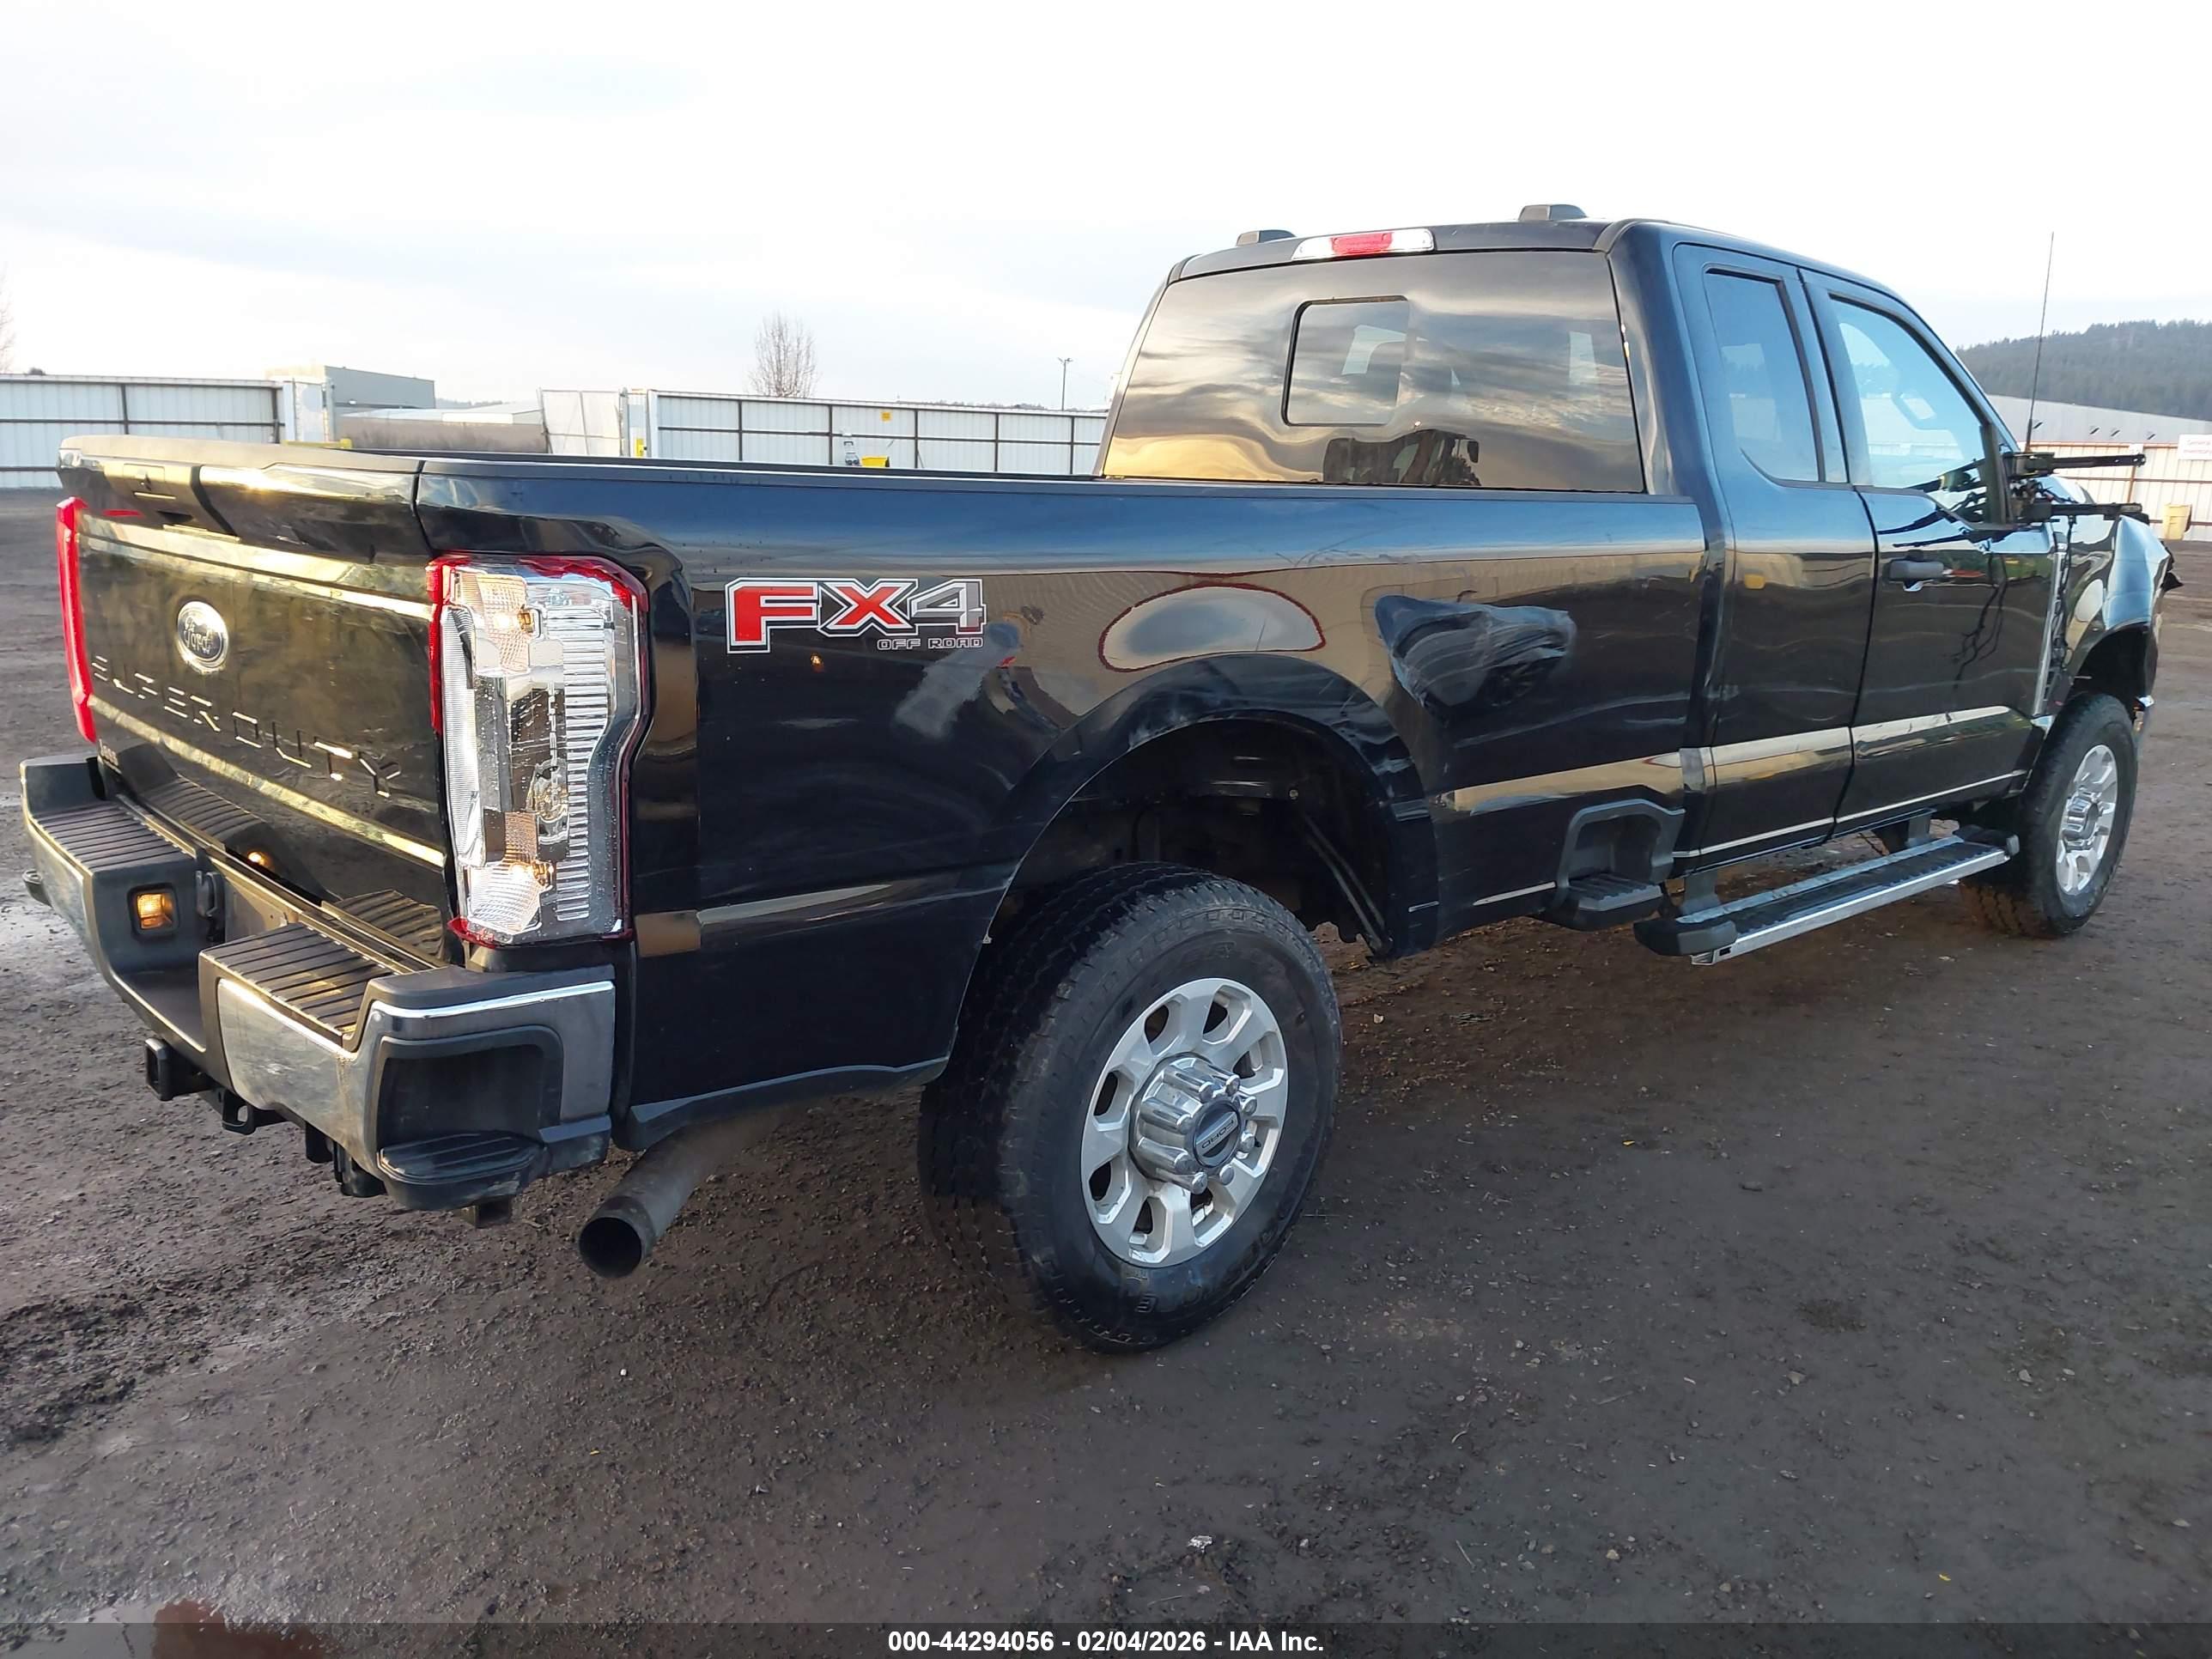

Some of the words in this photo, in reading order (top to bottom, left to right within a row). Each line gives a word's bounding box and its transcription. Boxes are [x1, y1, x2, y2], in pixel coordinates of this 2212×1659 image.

[726, 577, 986, 653] FX4
[182, 617, 213, 654] Ford
[877, 639, 921, 651] OFF
[928, 638, 983, 649] ROAD
[91, 655, 221, 732] SUPER
[231, 711, 401, 798] DUTY
[1201, 1119, 1234, 1148] FORD
